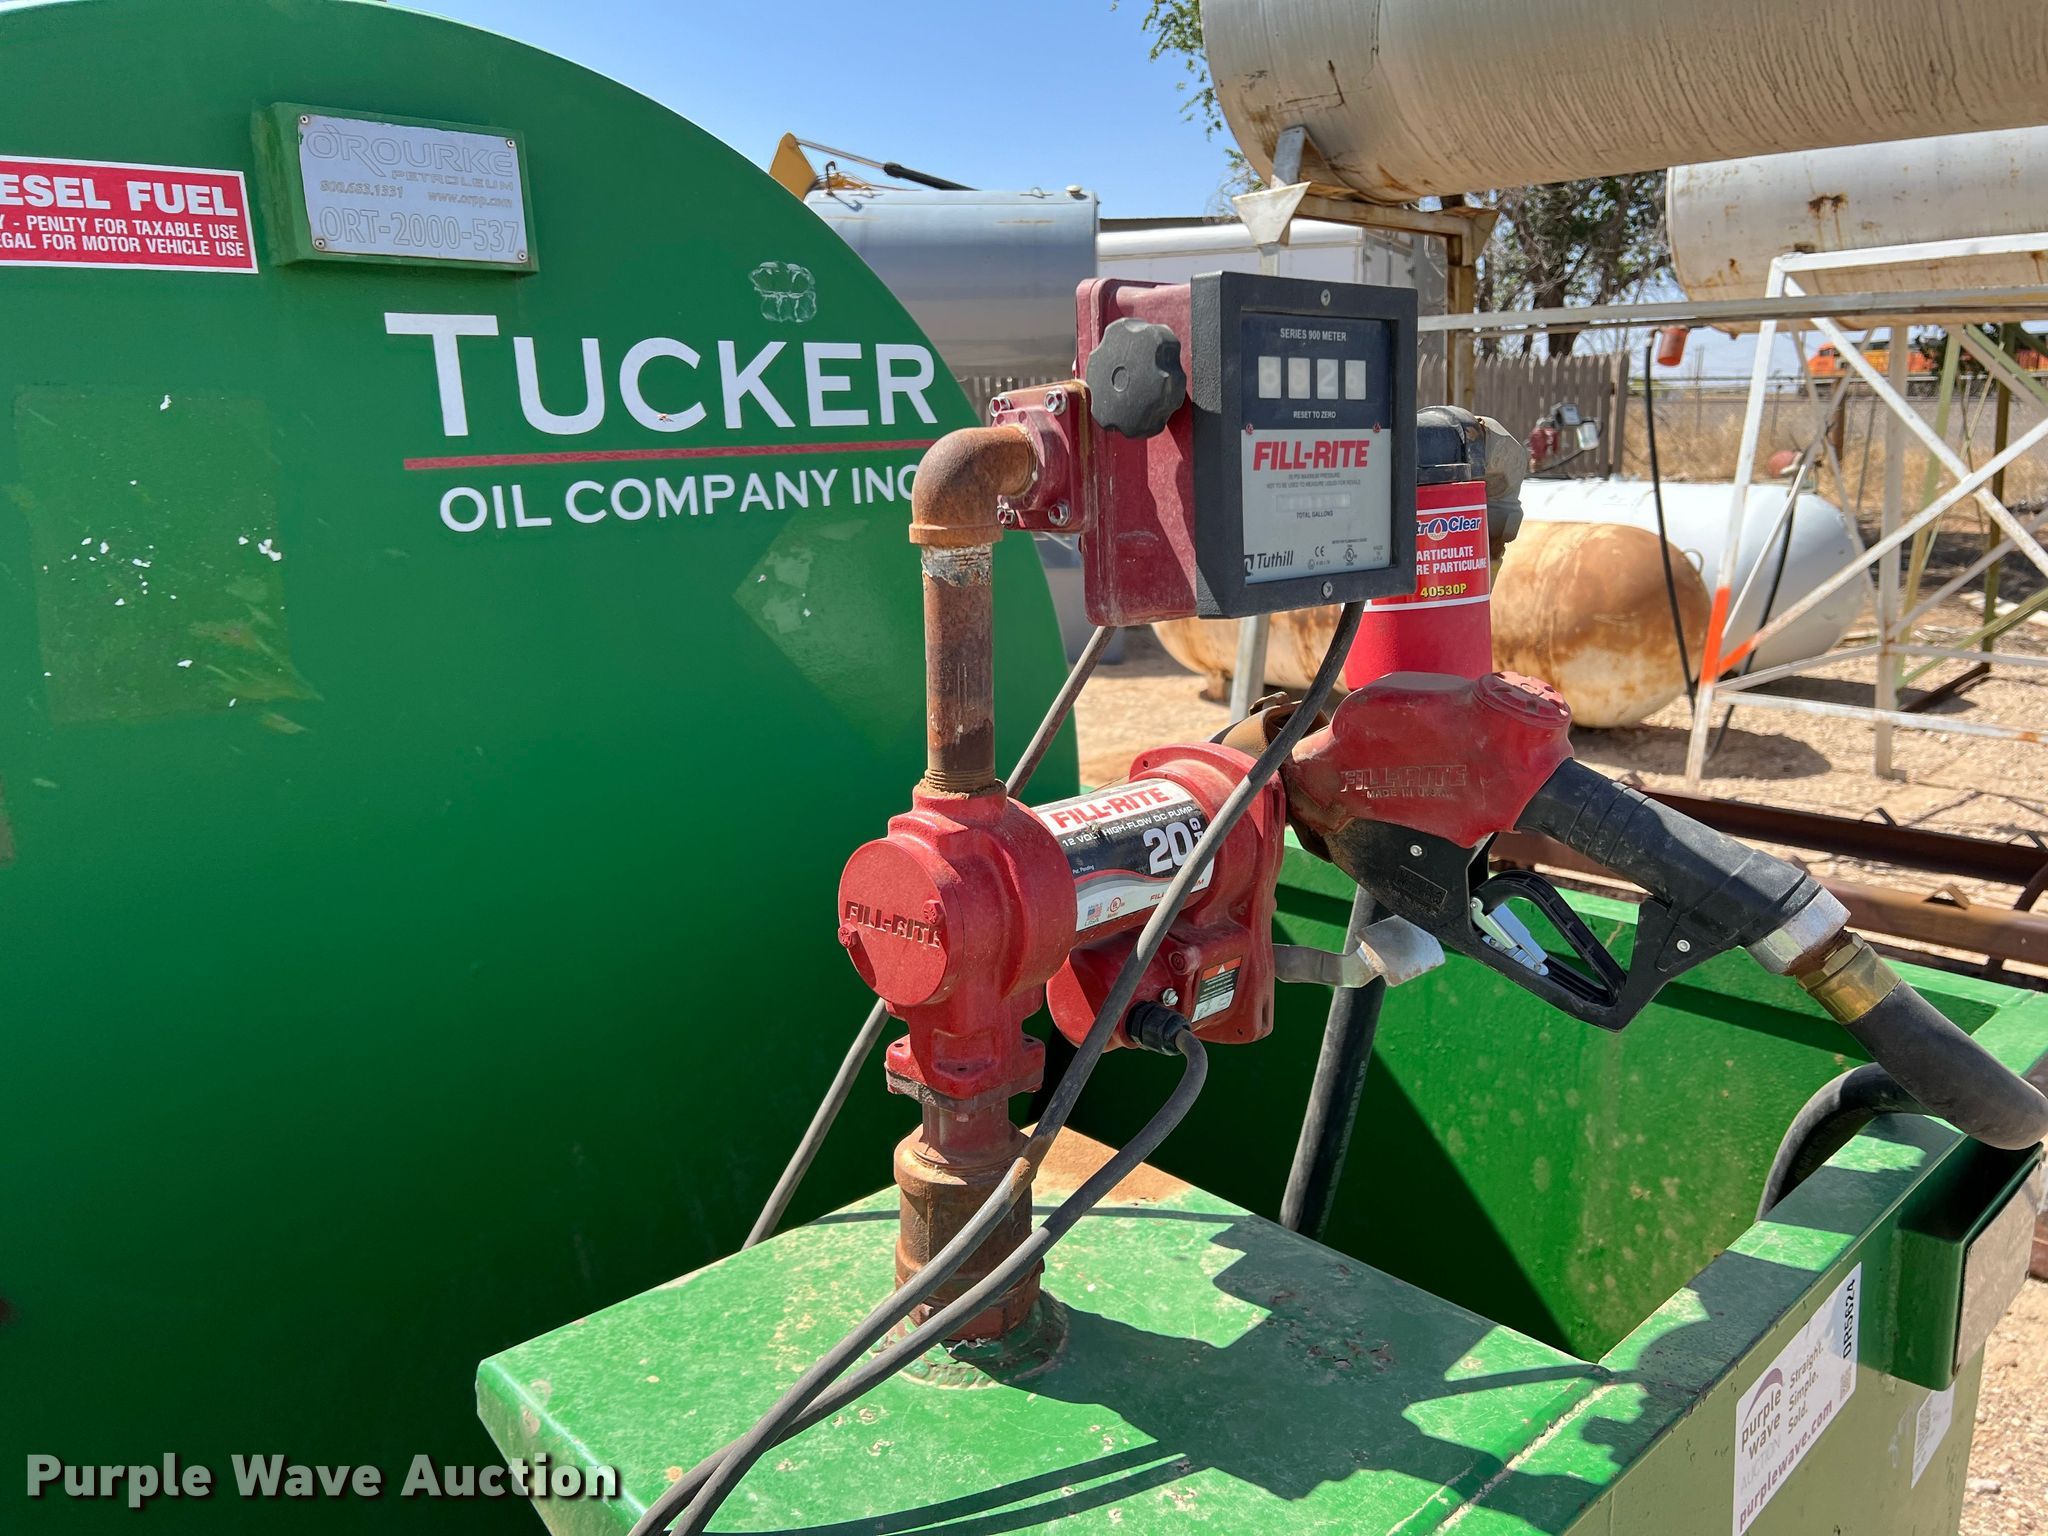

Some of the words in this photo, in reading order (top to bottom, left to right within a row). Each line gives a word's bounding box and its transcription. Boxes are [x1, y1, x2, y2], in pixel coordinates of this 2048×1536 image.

[0, 174, 111, 210] ESEL
[126, 181, 238, 217] FUEL
[392, 170, 513, 191] PETROLEUM
[26, 215, 88, 233] PENLTY
[94, 218, 128, 235] FOR
[132, 220, 202, 238] TAXABLE
[208, 224, 239, 240] USE
[42, 234, 77, 250] FOR
[83, 235, 141, 253] MOTOR
[146, 239, 210, 256] VEHICLE
[215, 241, 245, 257] USE
[319, 206, 519, 253] ORT-2000-537
[1280, 327, 1307, 340] SERIES
[1308, 331, 1321, 341] 900
[1322, 331, 1347, 342] METER
[384, 312, 939, 436] TUCKER
[1293, 411, 1312, 419] RESET
[1313, 411, 1320, 419] TO
[1321, 411, 1336, 419] ZERO
[1253, 440, 1370, 471] FILL-RITE
[440, 483, 553, 533] OIL
[565, 469, 838, 524] COMPANY
[1296, 511, 1311, 520] TOTAL
[1312, 510, 1333, 518] GALLONS
[1257, 550, 1294, 569] Tuthill
[1416, 546, 1473, 562] ARTICULATE
[1420, 583, 1467, 598] 40530P
[1049, 787, 1169, 829] FILL-RITE
[1062, 839, 1076, 848] 12
[1102, 816, 1153, 837] HIGH-FLOW
[1153, 813, 1168, 823] DC
[1169, 805, 1193, 819] PUMP
[1142, 821, 1194, 875] 20
[845, 901, 940, 948] FILL-RITE
[1788, 1371, 1819, 1412] Simple.
[1741, 1389, 1782, 1453] purple
[1748, 1412, 1781, 1460] wave
[1787, 1401, 1808, 1435] Sold.
[1739, 1400, 1833, 1532] purplewave.com
